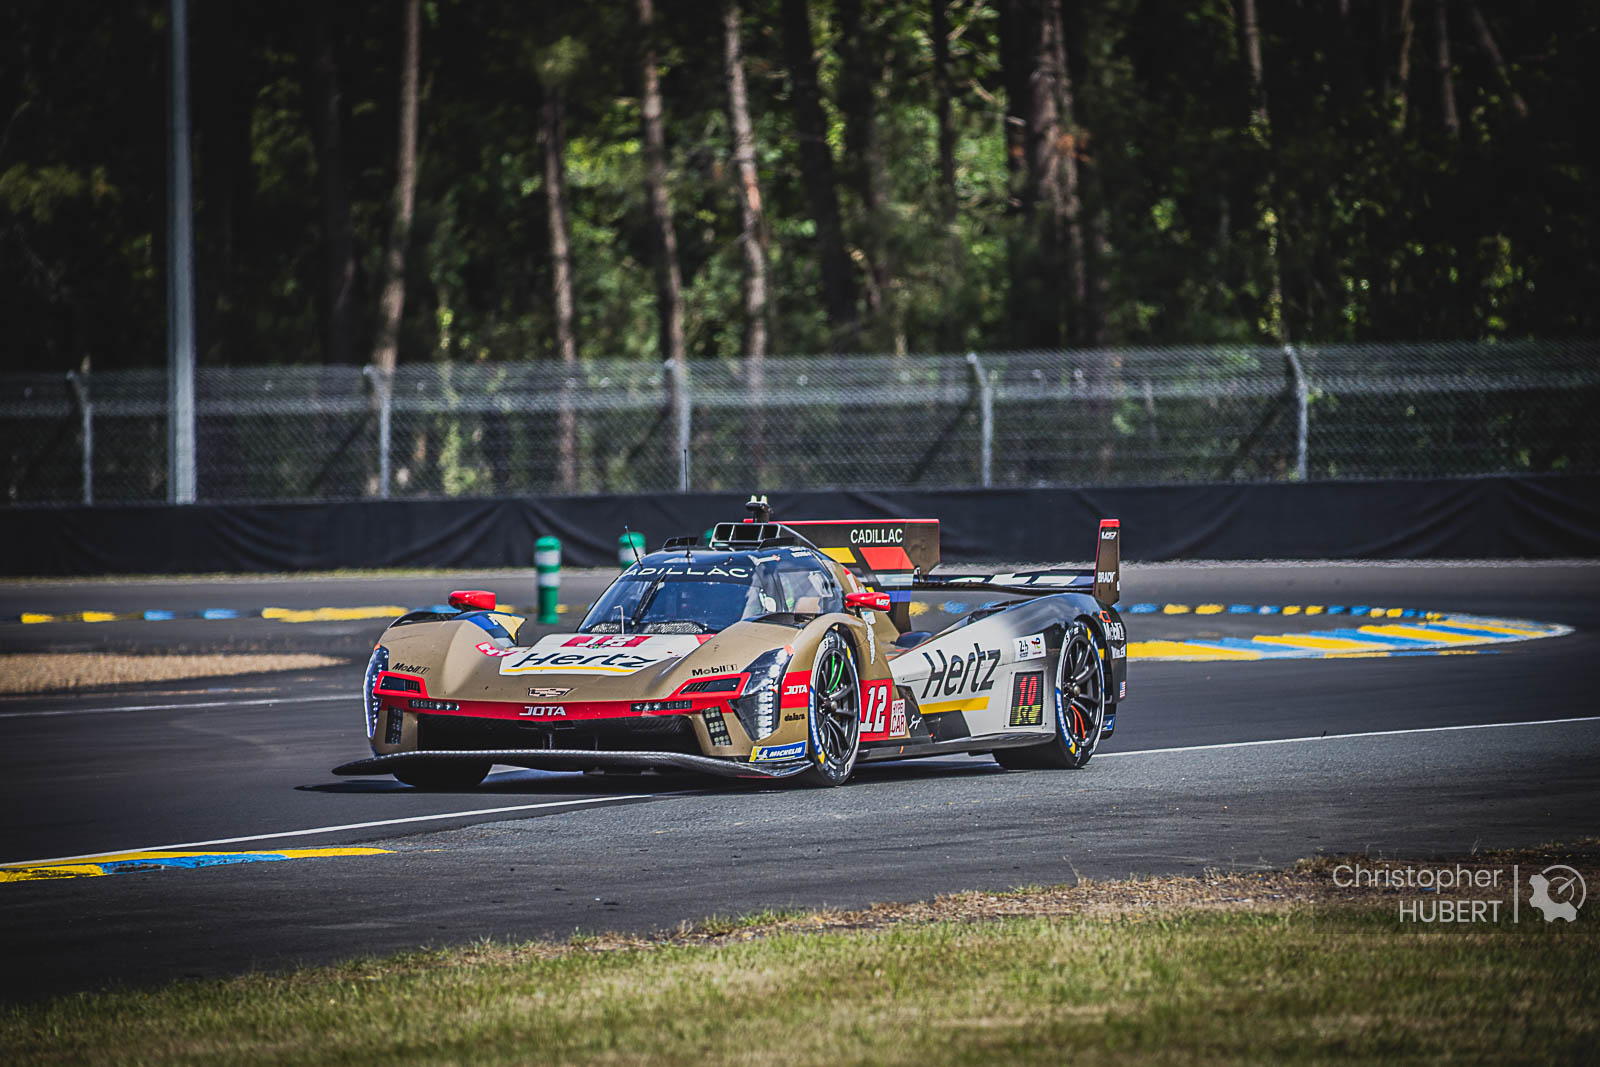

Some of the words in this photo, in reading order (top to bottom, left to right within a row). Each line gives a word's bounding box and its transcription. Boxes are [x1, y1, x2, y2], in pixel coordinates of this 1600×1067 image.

[850, 528, 903, 544] CADILLAC
[512, 653, 658, 668] Hertz
[392, 662, 419, 675] Mobil
[692, 665, 726, 677] Mobil
[921, 642, 1002, 700] Hertz
[784, 684, 808, 696] JOTA
[519, 706, 566, 716] JOTA
[860, 685, 887, 733] 12
[891, 715, 905, 733] CAR
[769, 746, 803, 758] MICHELIN
